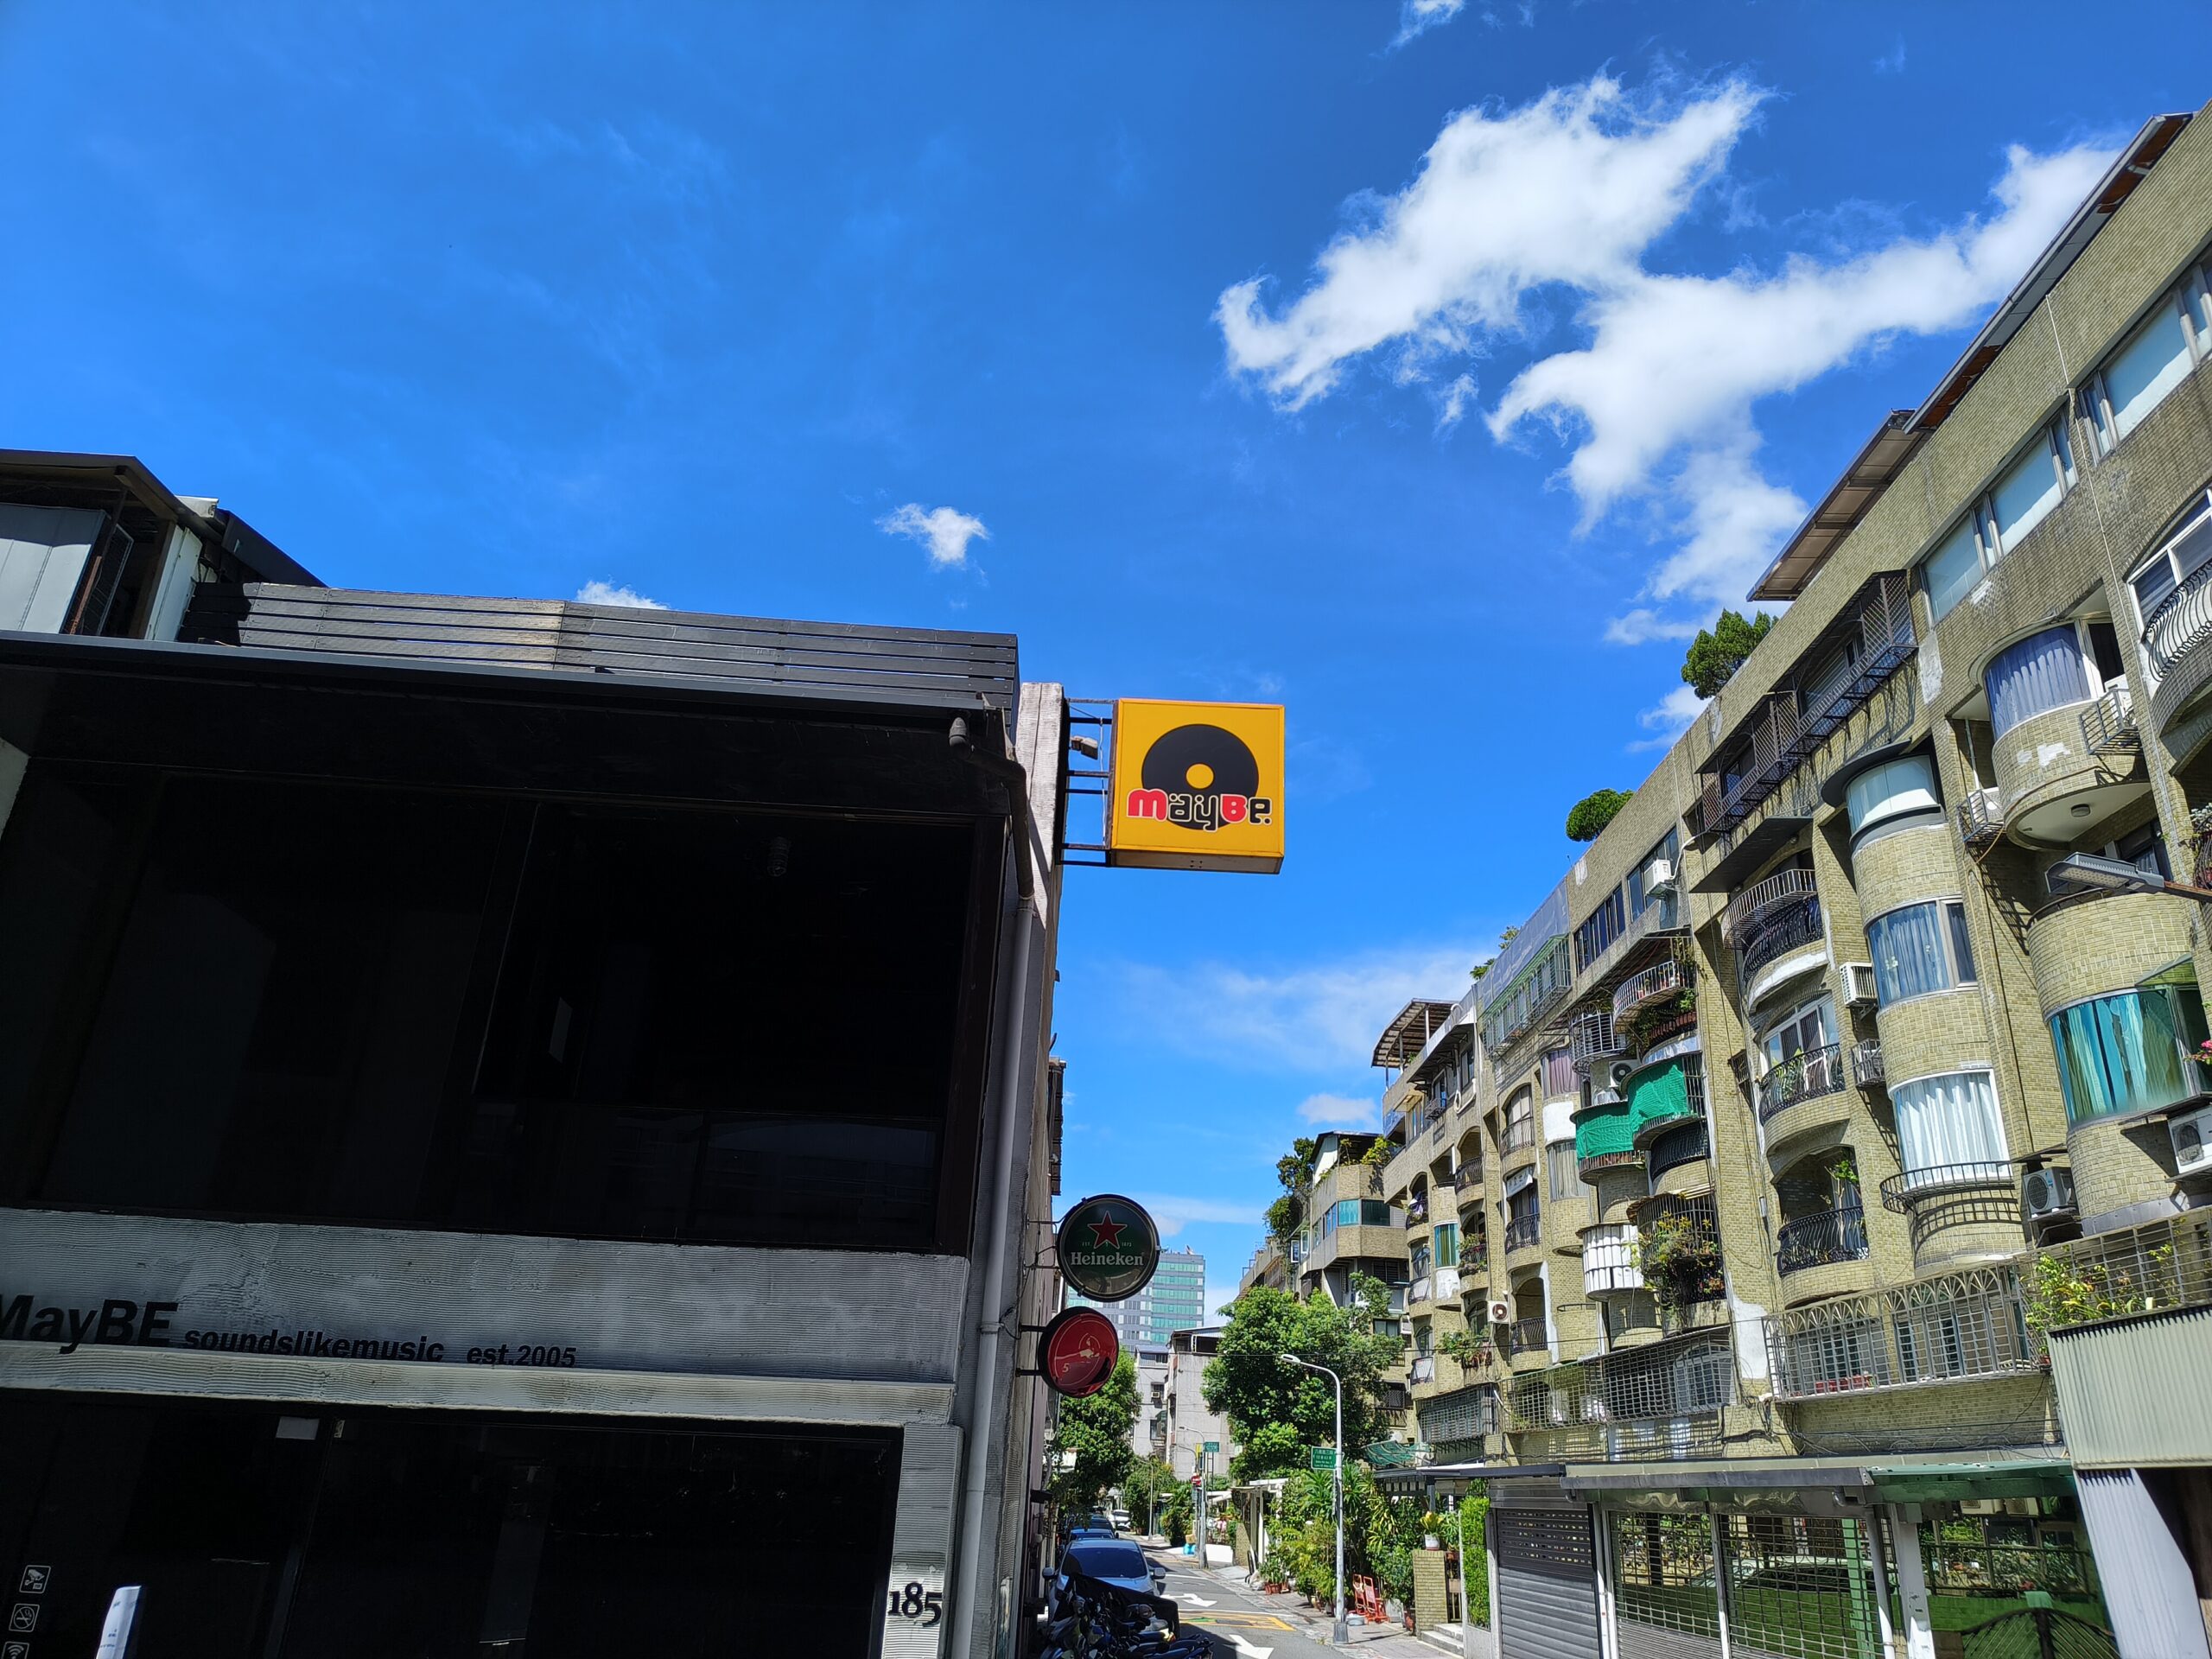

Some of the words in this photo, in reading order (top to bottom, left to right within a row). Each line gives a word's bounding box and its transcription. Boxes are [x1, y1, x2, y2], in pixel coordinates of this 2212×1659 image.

[1071, 1251, 1144, 1266] Heineken
[185, 1329, 444, 1362] soundslikemusic
[467, 1344, 576, 1368] est.2005
[887, 1582, 943, 1627] 185
